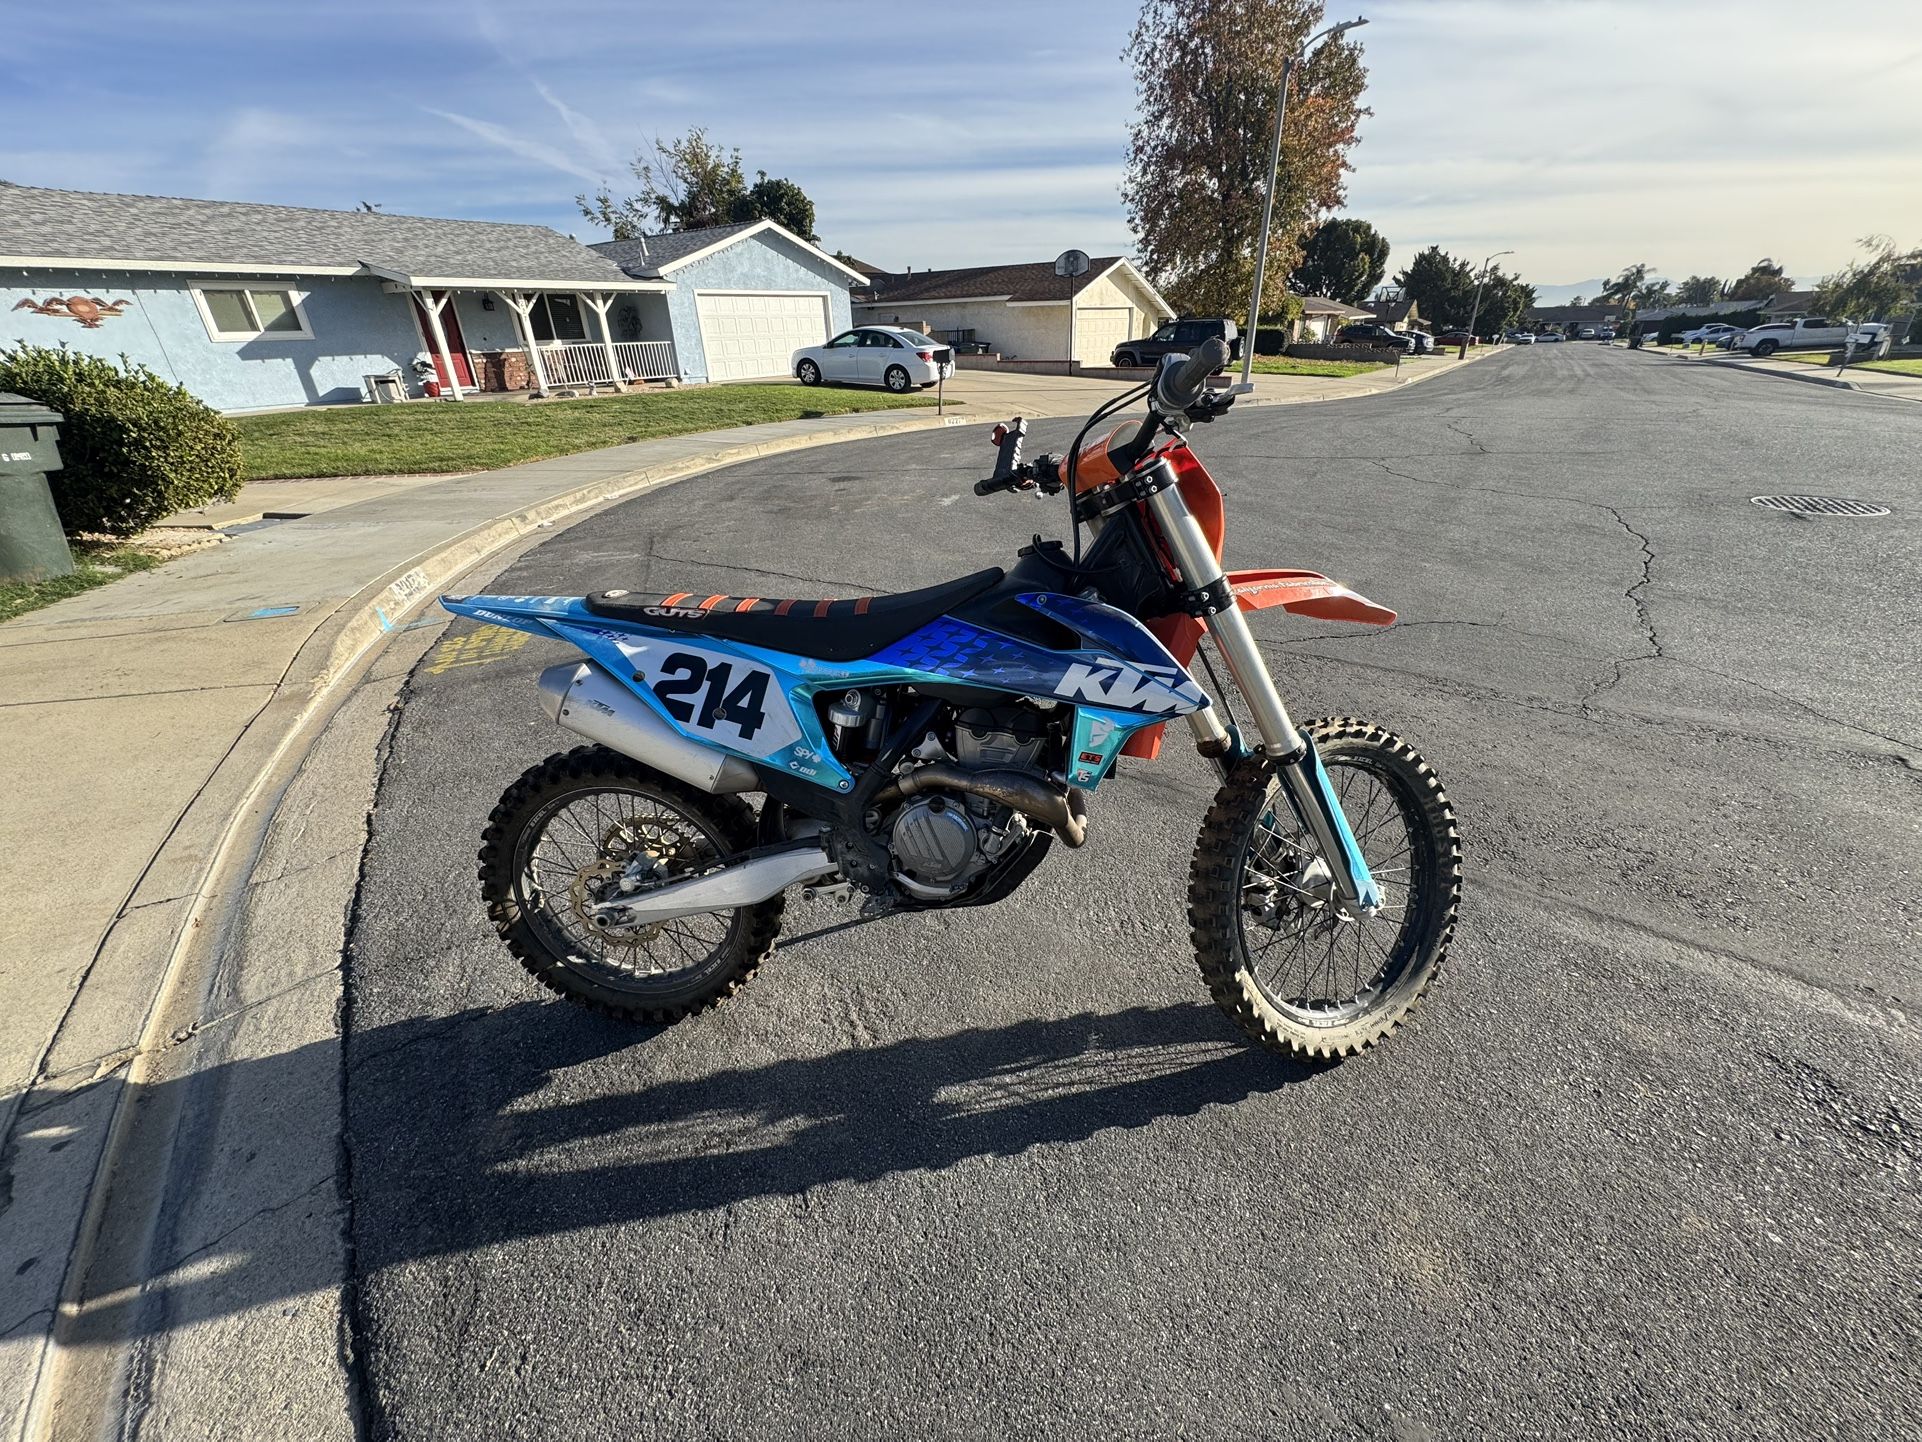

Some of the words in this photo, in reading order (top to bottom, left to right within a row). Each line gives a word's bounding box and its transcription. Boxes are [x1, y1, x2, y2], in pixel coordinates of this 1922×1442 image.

[472, 608, 533, 625] DUNLOP
[643, 606, 706, 619] GUTS
[652, 652, 771, 741] 214
[1053, 656, 1203, 715] KTM
